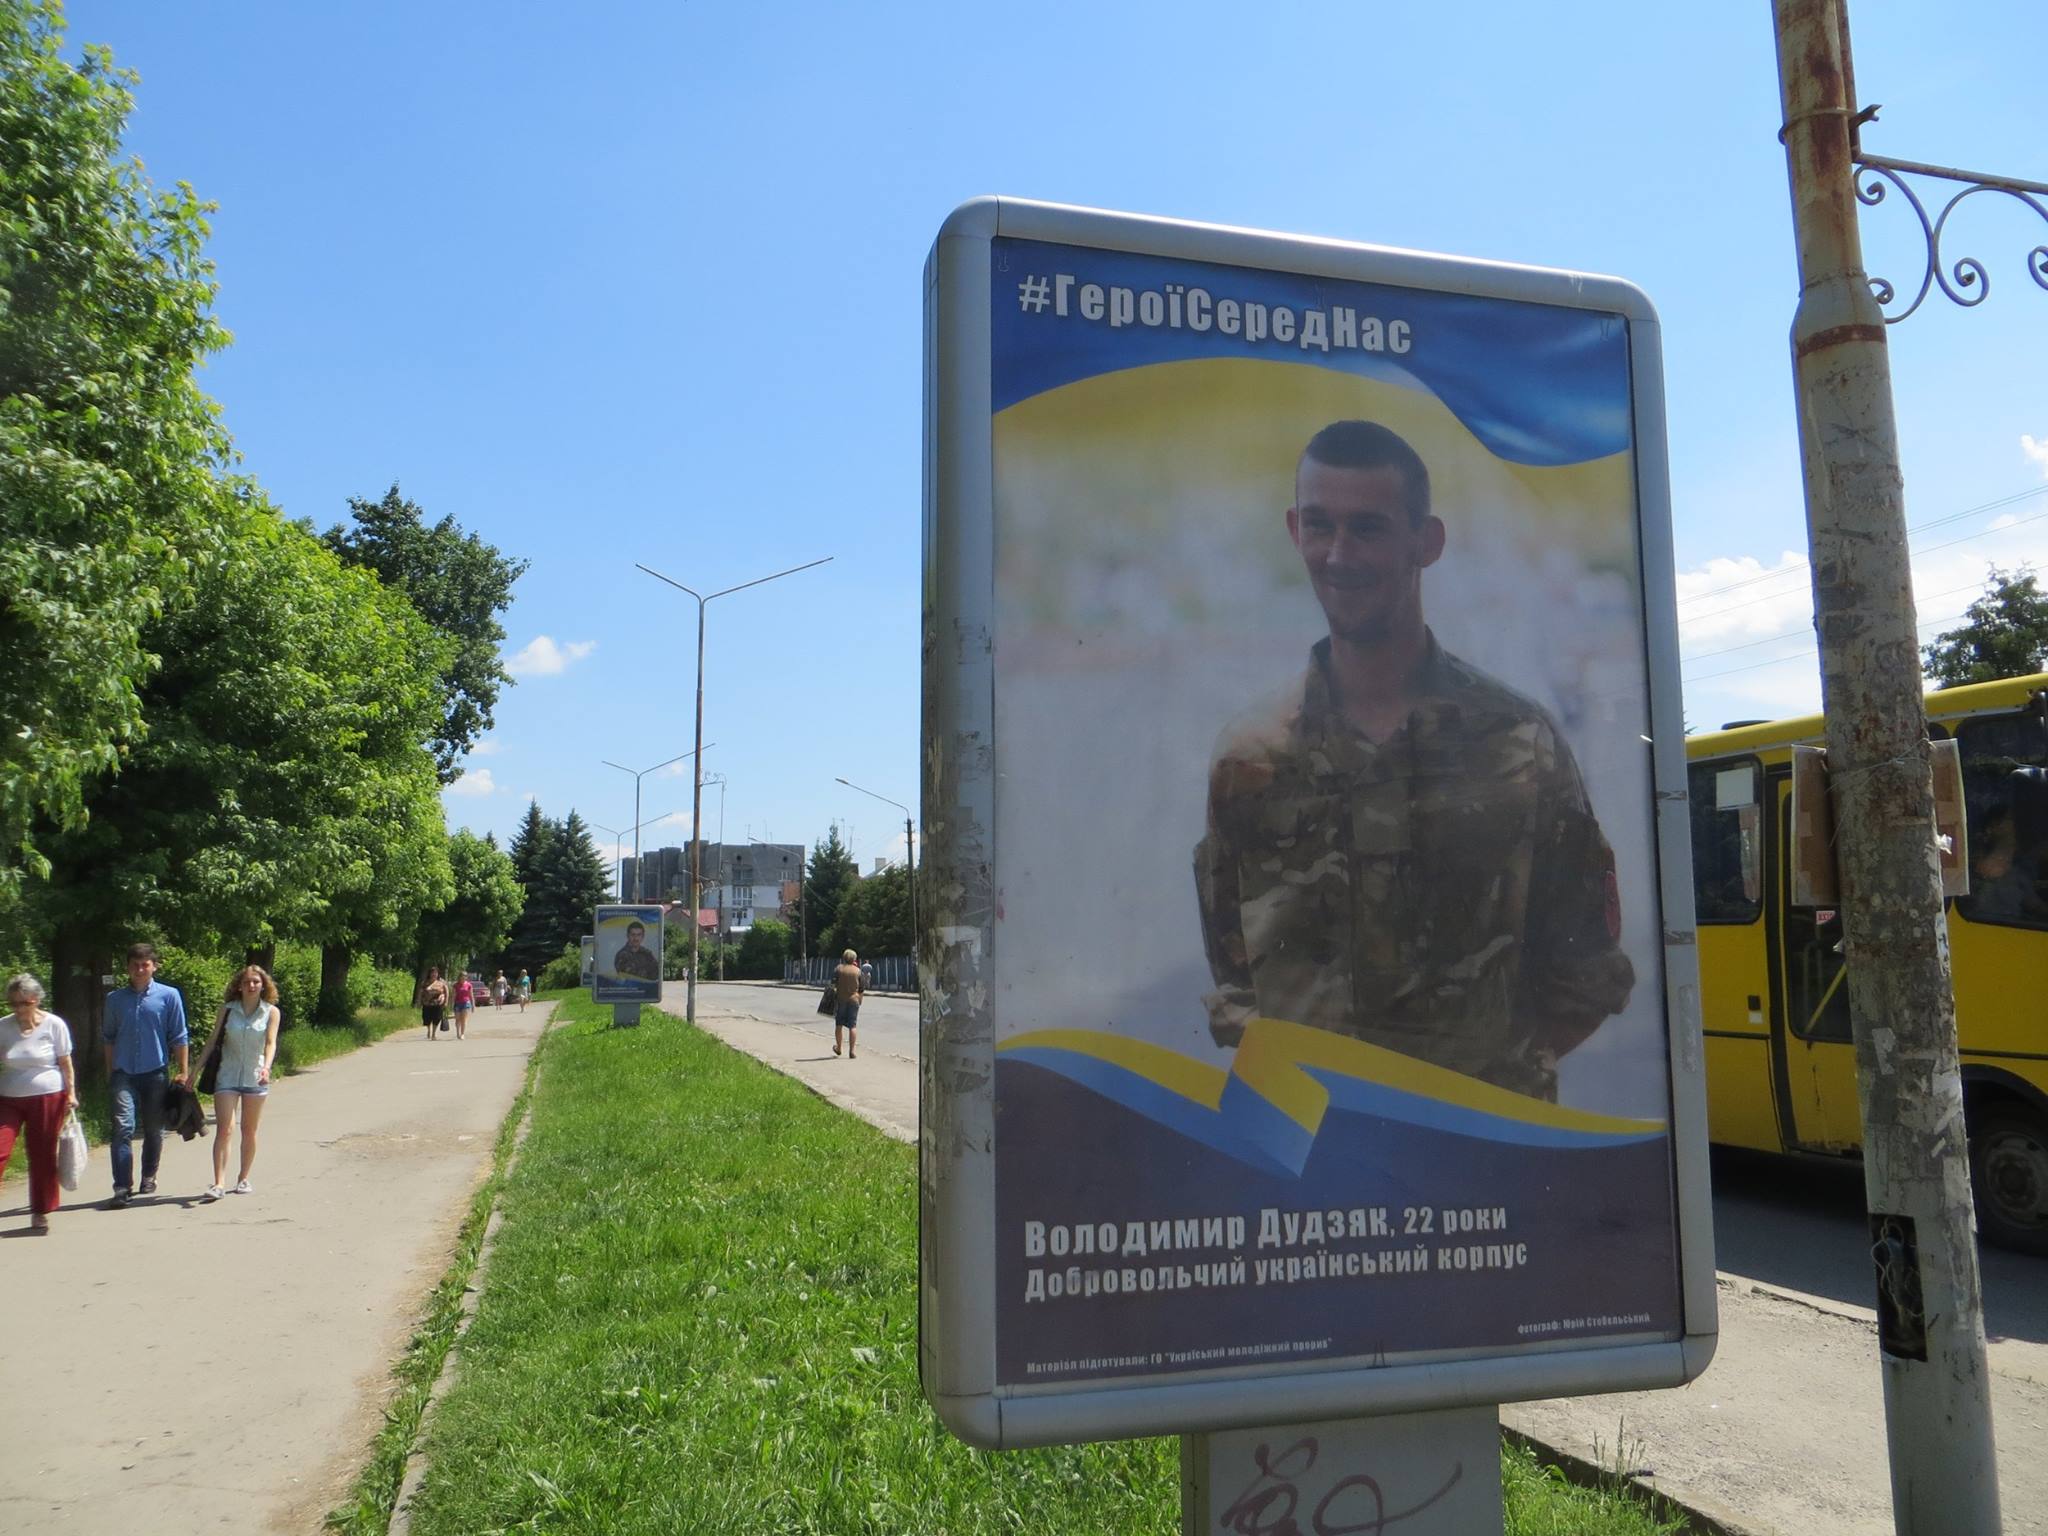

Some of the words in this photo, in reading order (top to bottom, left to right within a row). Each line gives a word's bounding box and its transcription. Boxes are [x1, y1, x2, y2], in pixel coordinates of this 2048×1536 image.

[1018, 274, 1411, 353] #ГероїСередНас
[1025, 1216, 1245, 1257] Володимир
[1258, 1208, 1396, 1249] Дудзяк,
[1403, 1206, 1434, 1234] 22
[1443, 1207, 1507, 1235] роки
[1025, 1256, 1246, 1303] Добровольчий
[1255, 1243, 1428, 1285] український
[1438, 1243, 1527, 1270] корпус
